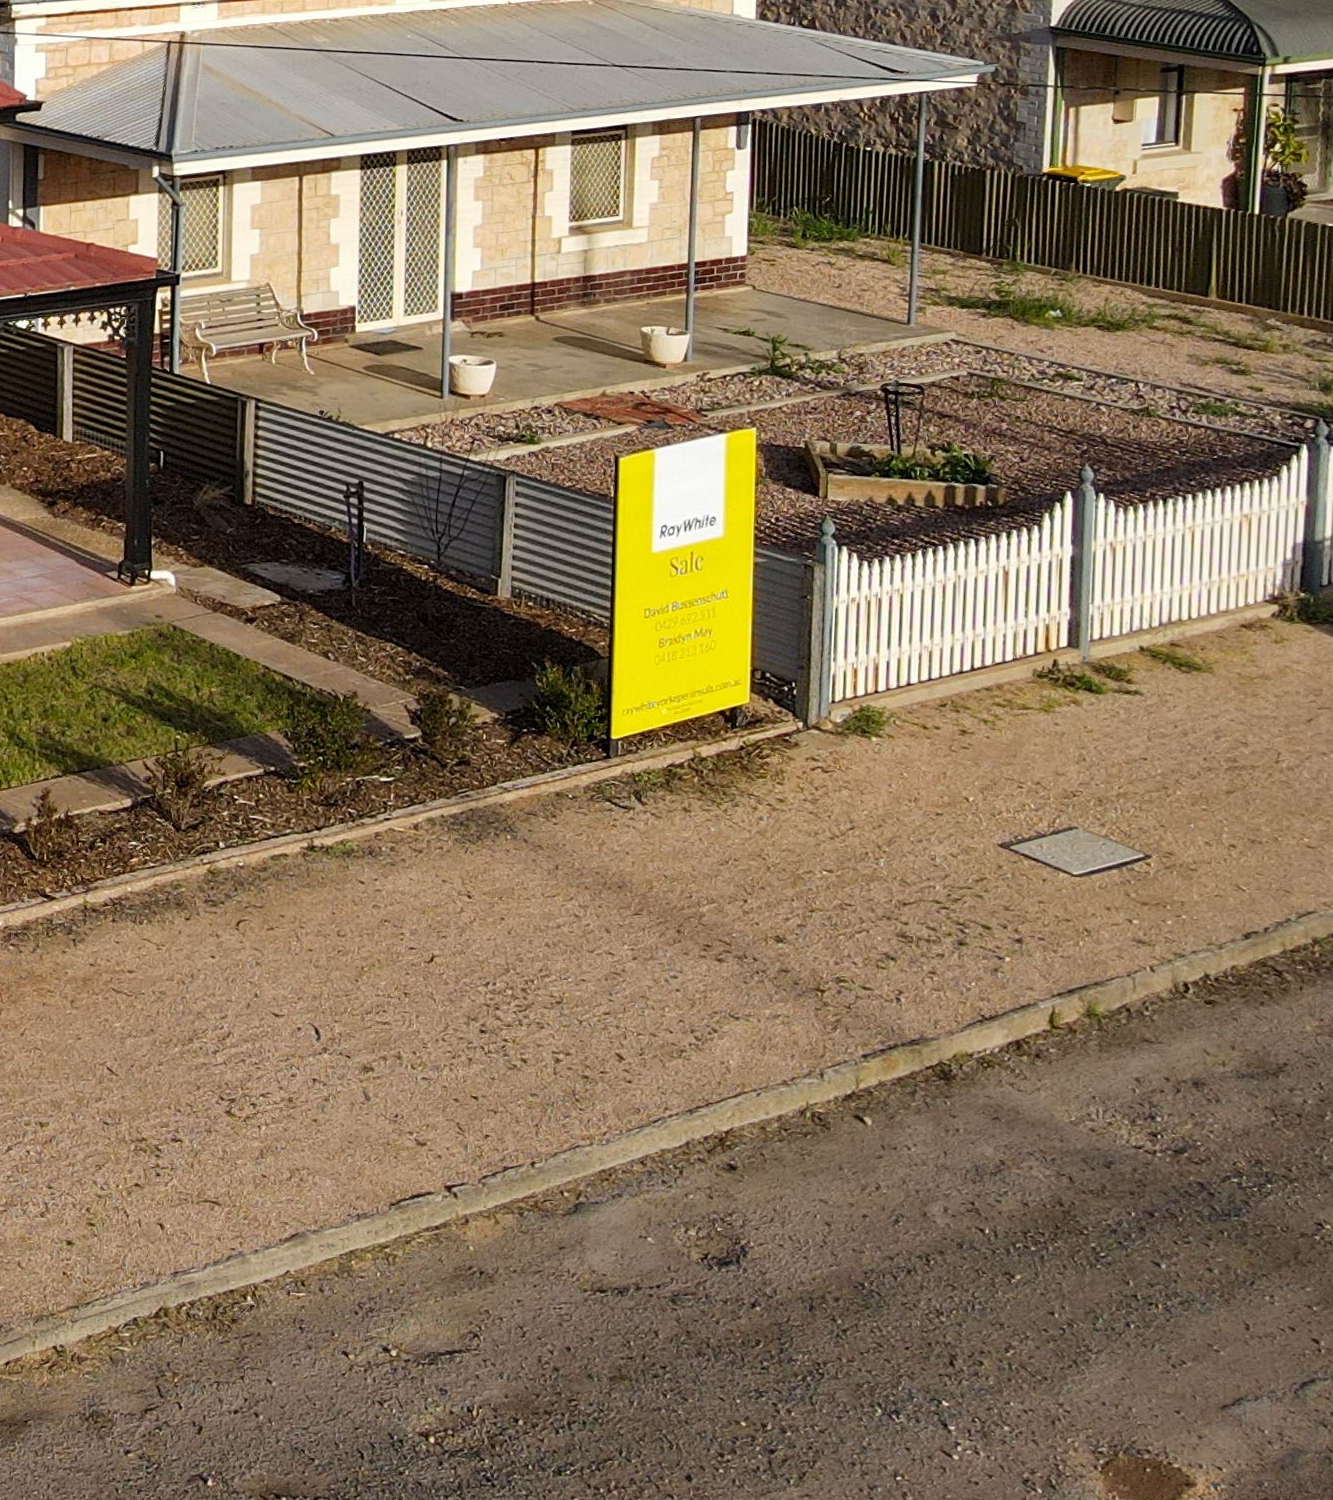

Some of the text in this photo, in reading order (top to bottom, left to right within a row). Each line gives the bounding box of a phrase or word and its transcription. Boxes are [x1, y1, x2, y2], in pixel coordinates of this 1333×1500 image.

[669, 552, 704, 578] Sale
[644, 604, 670, 619] David
[694, 627, 713, 639] May
